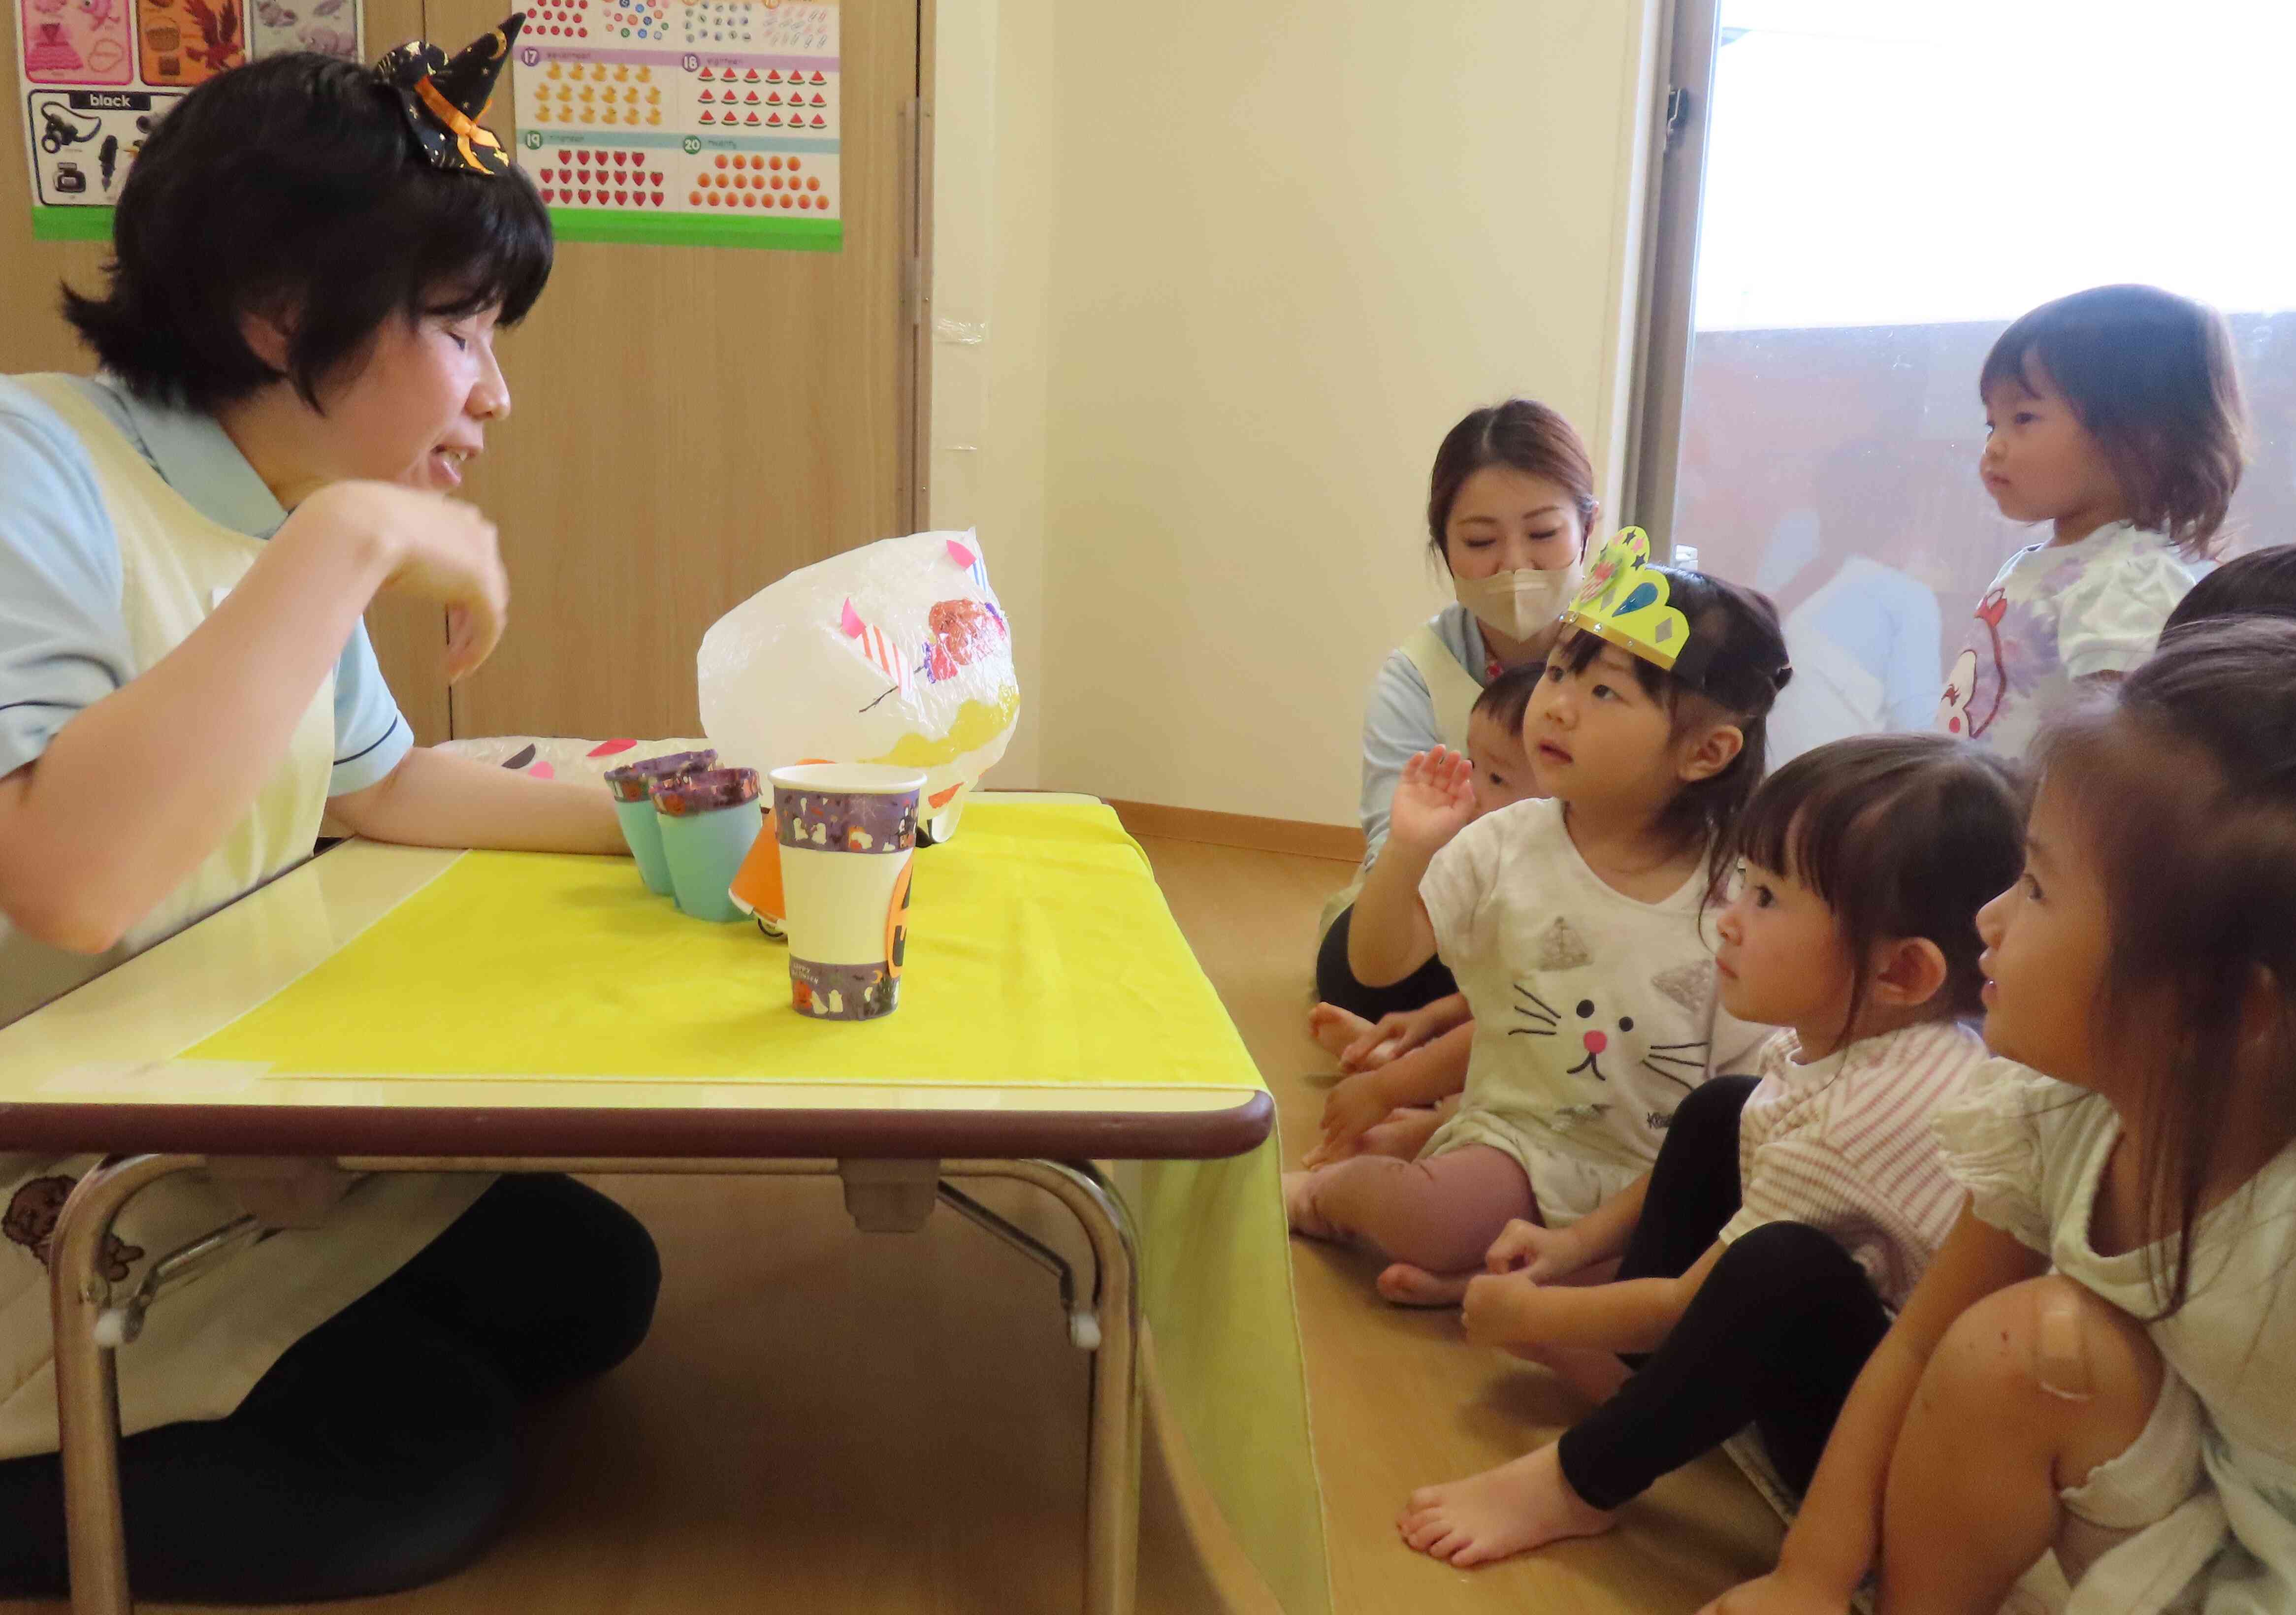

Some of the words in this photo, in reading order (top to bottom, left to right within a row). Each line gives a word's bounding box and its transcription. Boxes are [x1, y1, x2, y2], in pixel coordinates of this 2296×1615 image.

[524, 50, 537, 64] 17
[683, 56, 698, 69] 18
[90, 94, 131, 107] black
[527, 133, 541, 147] 19
[684, 138, 701, 151] 20
